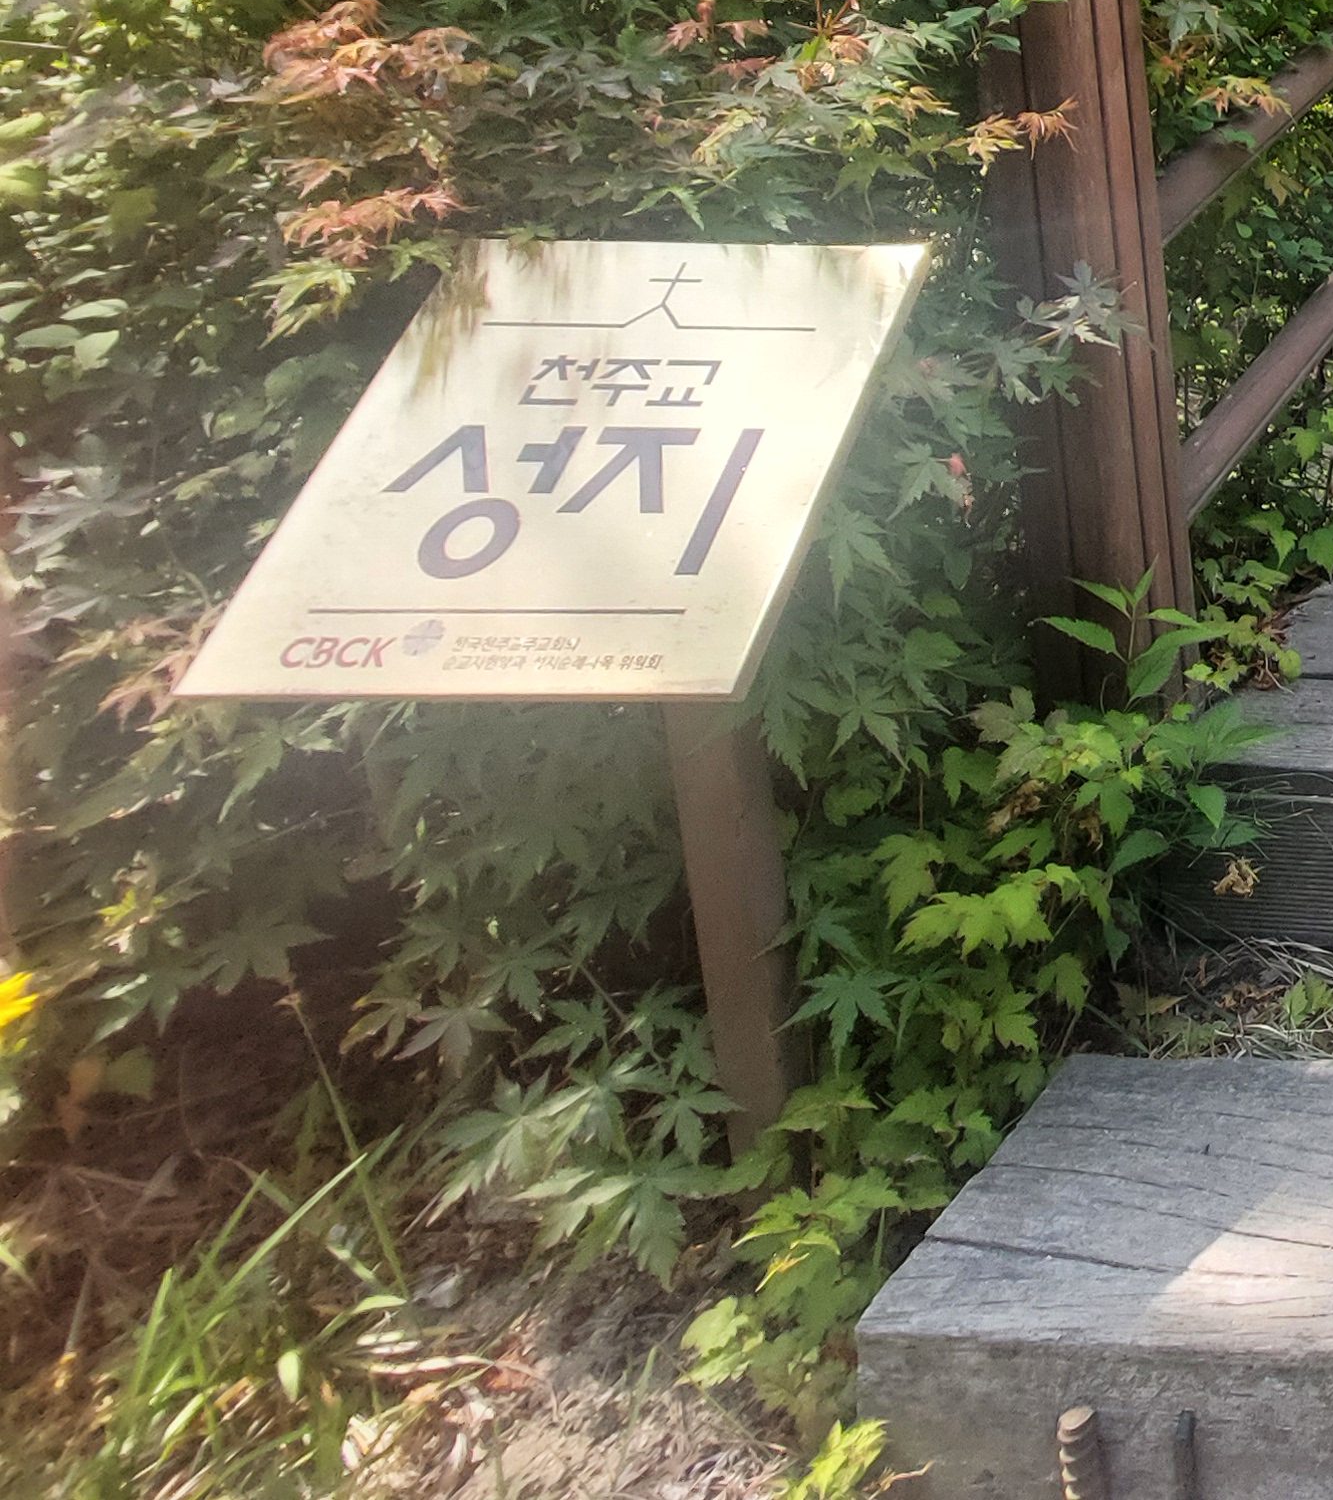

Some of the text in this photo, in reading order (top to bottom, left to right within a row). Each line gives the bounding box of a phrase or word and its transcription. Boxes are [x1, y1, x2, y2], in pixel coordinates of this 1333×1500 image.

[518, 355, 722, 407] 천주교
[381, 424, 764, 580] 성지
[279, 636, 397, 669] CBCK
[618, 653, 664, 671] 위원회
